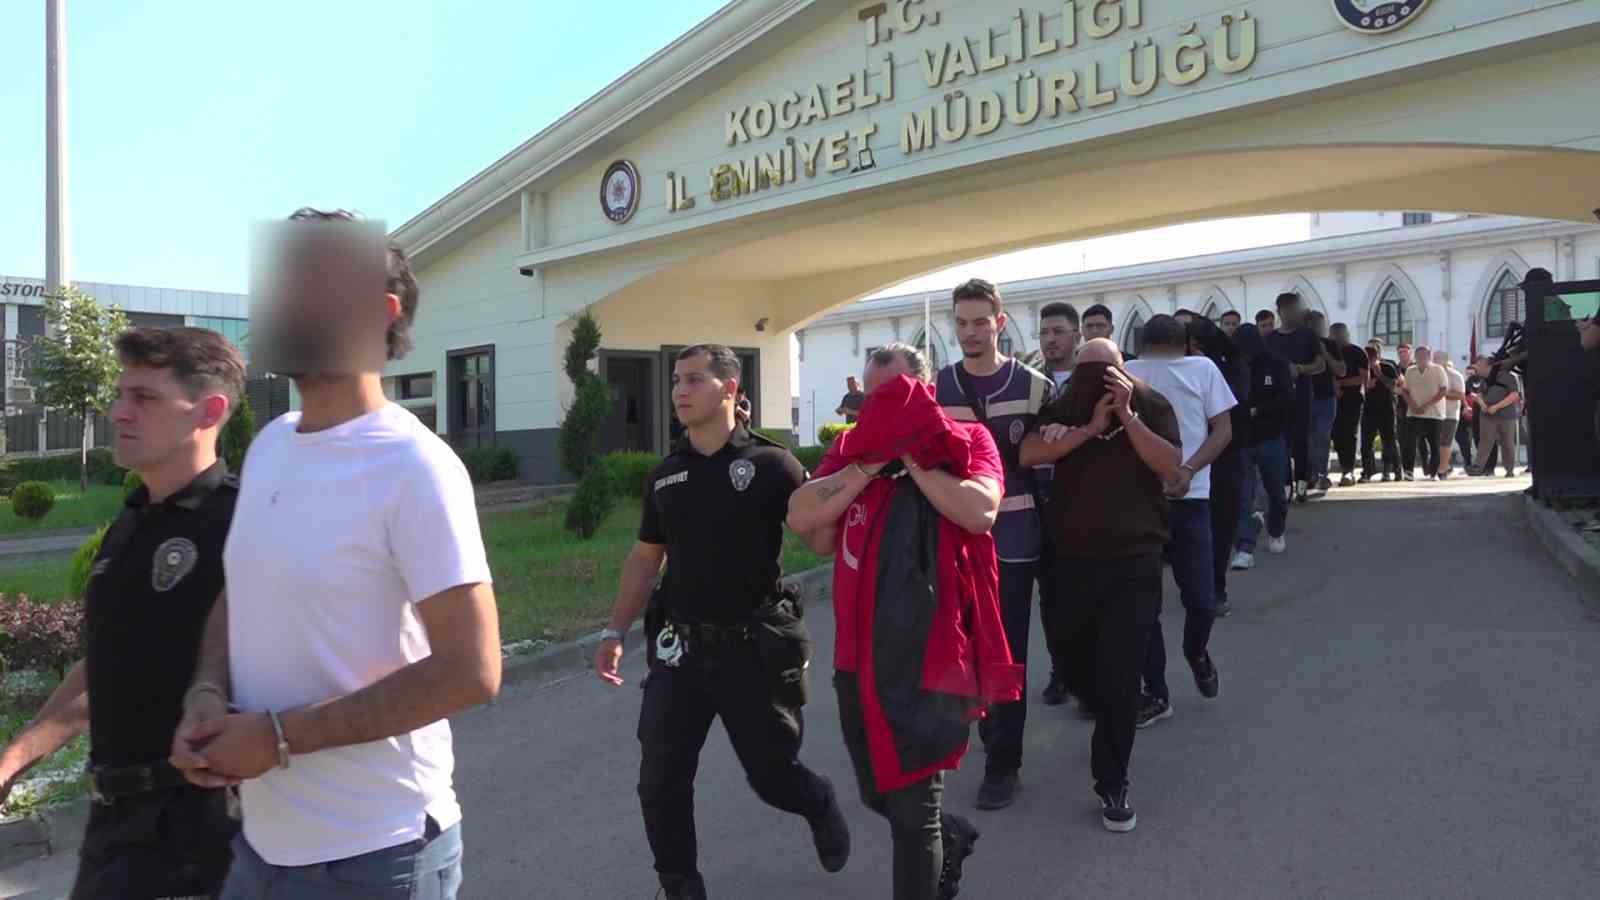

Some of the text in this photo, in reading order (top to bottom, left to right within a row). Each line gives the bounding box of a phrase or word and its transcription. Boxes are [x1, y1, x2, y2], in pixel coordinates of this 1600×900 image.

[858, 0, 941, 46] T.C.
[665, 10, 1257, 212] İL EMNİYET MÜDÜRLÜĞÜ
[725, 52, 893, 147] KOCAELİ
